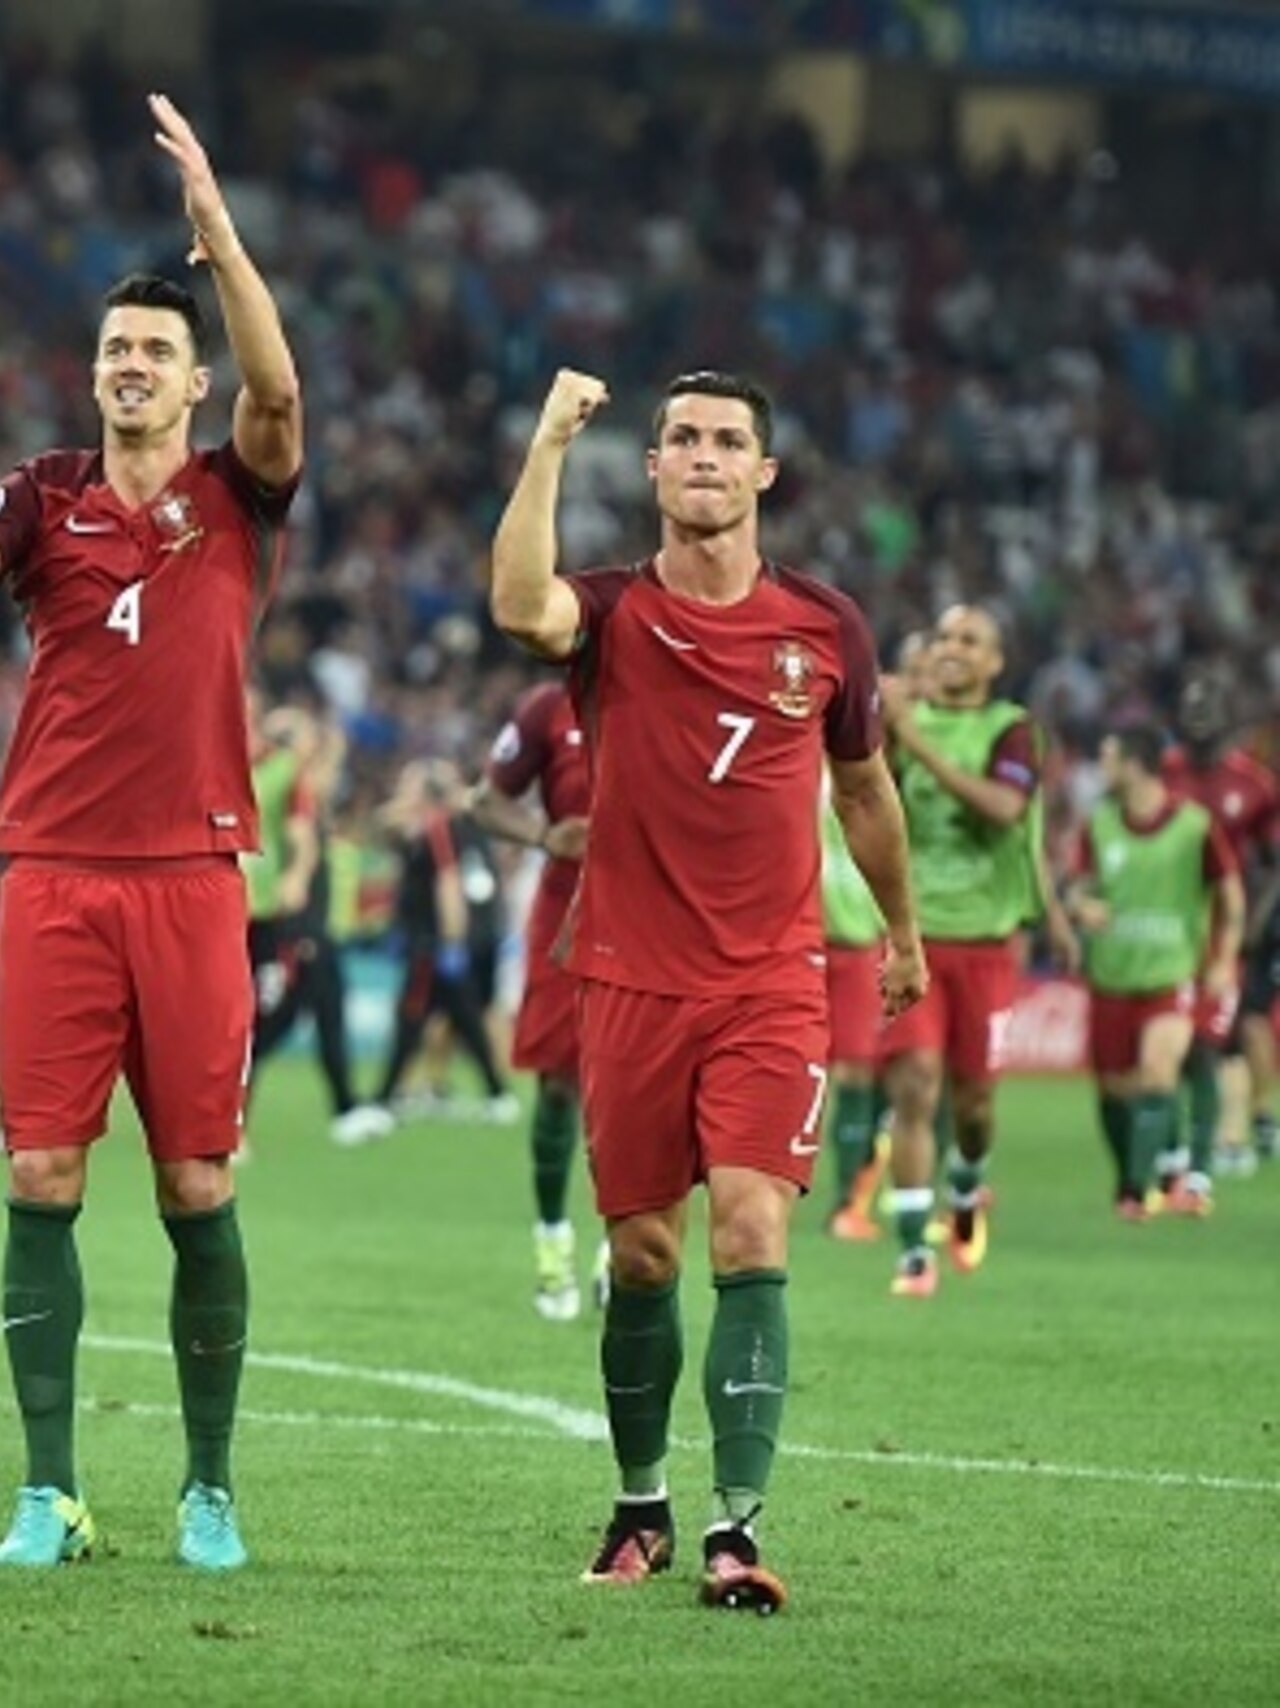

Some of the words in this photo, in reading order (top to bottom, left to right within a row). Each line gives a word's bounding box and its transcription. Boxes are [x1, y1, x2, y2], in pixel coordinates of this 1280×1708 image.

[105, 578, 145, 646] 4
[708, 712, 757, 784] 7
[803, 1062, 827, 1134] 7
